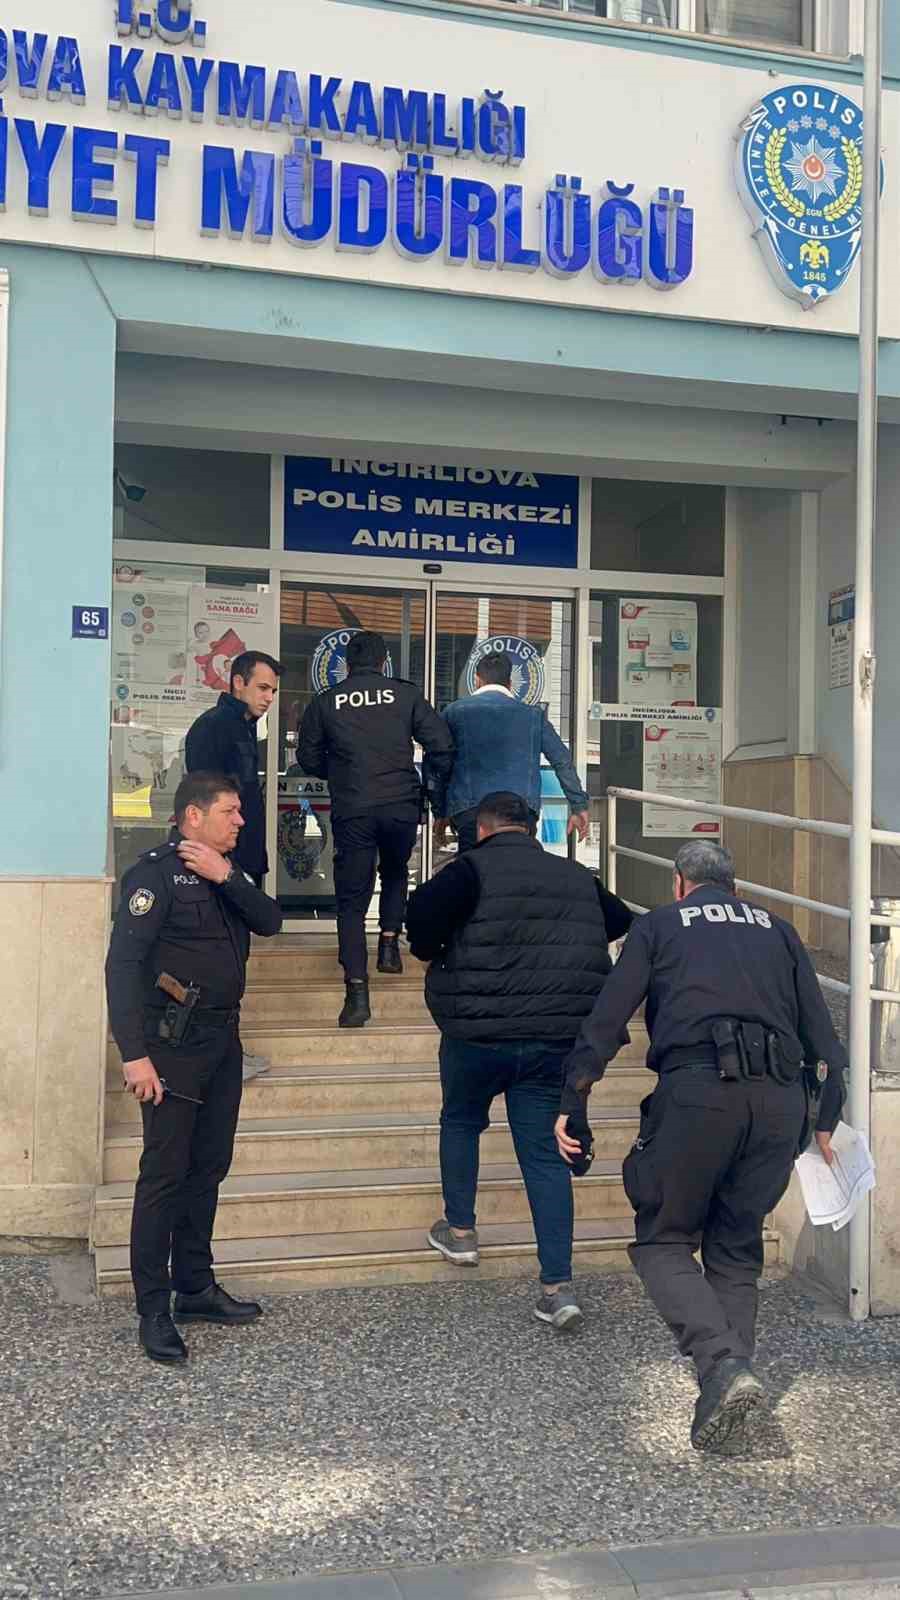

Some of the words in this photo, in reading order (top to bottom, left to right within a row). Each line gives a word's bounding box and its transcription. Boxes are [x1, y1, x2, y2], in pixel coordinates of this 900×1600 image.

[0, 28, 86, 98] VA
[107, 44, 526, 160] KAYMAKAMLIĞI
[773, 91, 856, 125] POLİS
[202, 138, 694, 286] MÜDÜRLÜĞÜ
[787, 217, 840, 236] GENEL
[293, 488, 402, 513] POLİS
[415, 498, 572, 525] MERKEZİ
[352, 528, 515, 555] AMİRLİĞİ
[82, 611, 100, 626] 65
[335, 689, 395, 710] POLİS
